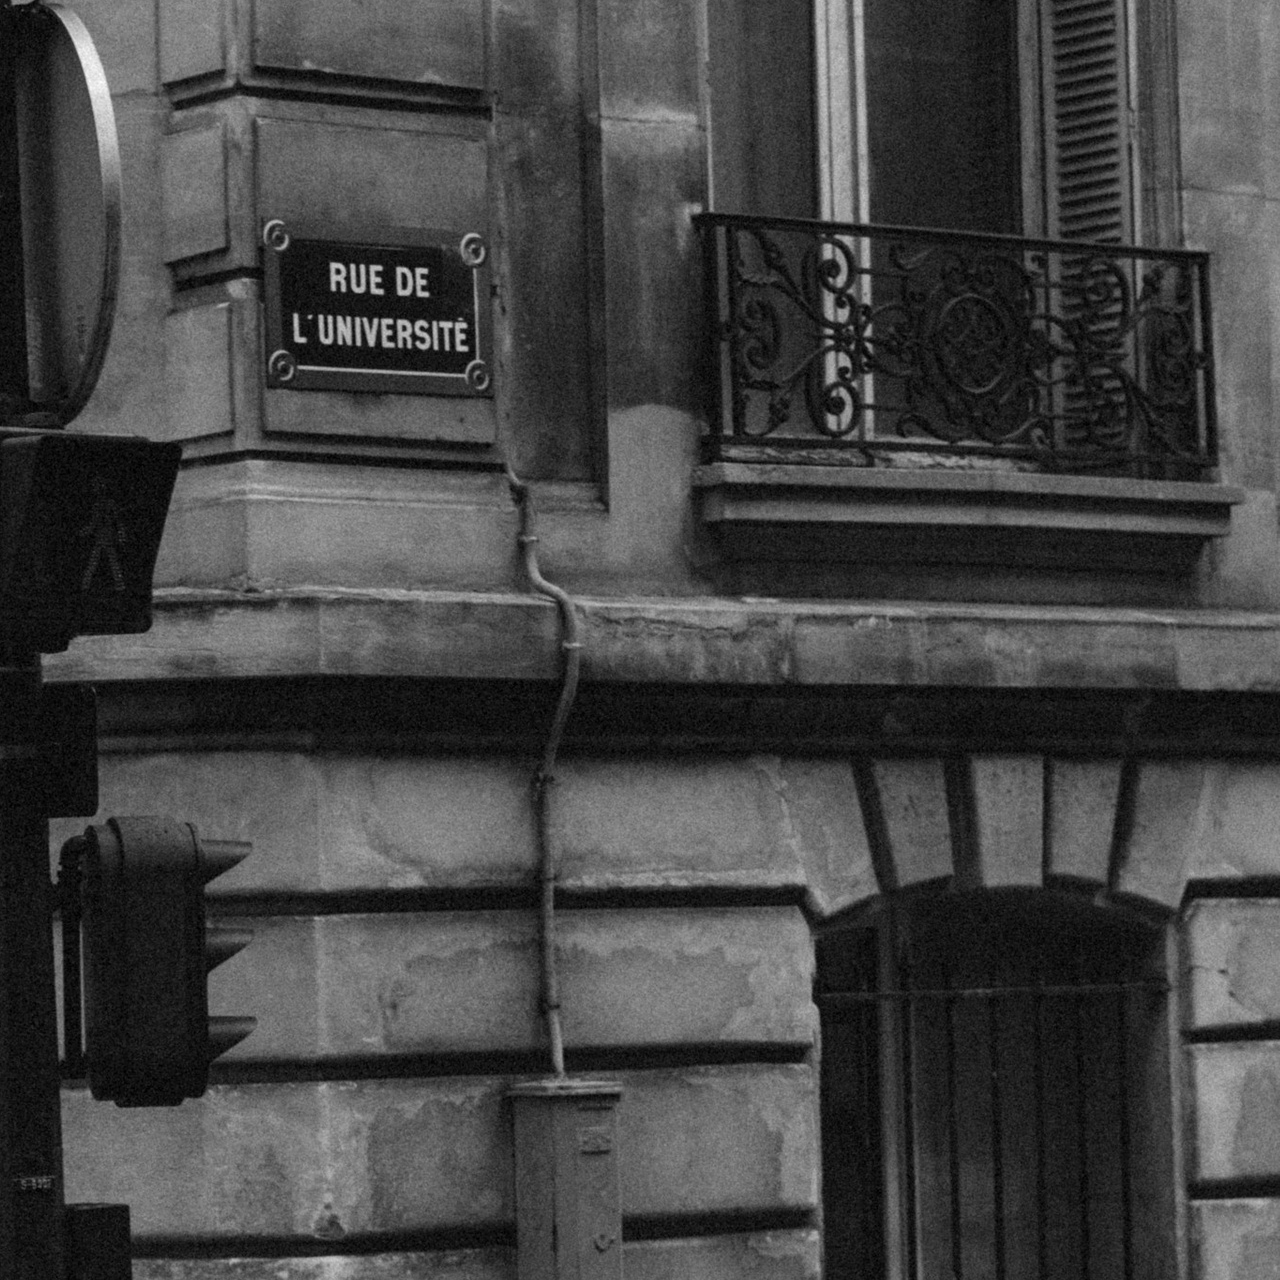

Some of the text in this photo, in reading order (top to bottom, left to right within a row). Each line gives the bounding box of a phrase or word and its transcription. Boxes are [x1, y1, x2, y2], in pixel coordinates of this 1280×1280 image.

[329, 261, 430, 298] RUE DE
[292, 312, 470, 353] L'UNIVERSITÉ
